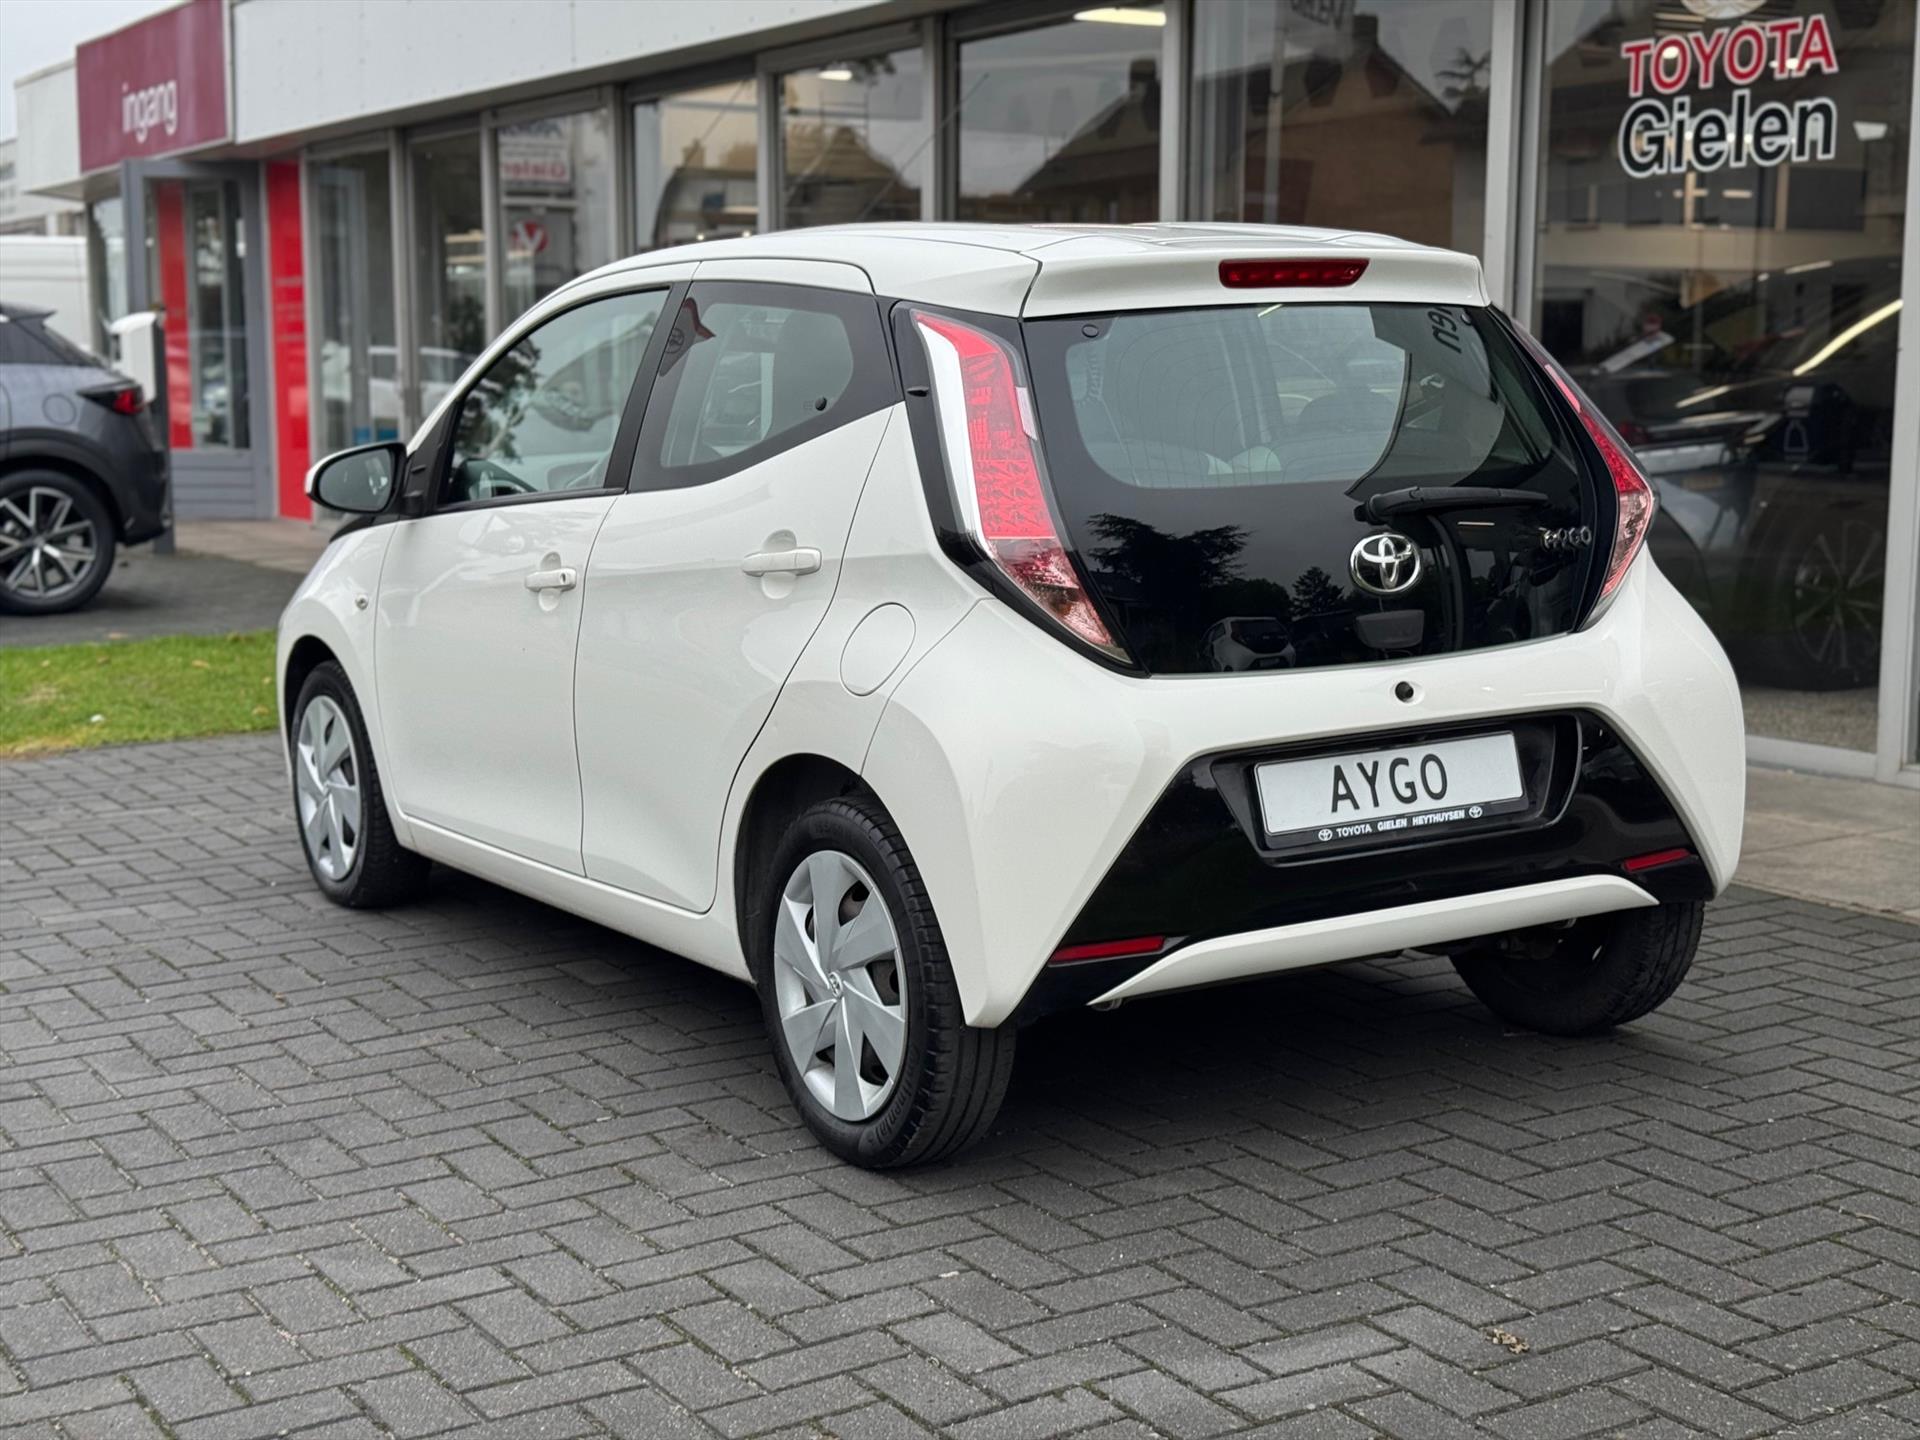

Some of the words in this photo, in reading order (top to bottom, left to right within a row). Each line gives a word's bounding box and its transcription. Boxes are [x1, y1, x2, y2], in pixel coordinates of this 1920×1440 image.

[1621, 14, 1838, 98] TOYOTA
[121, 81, 178, 144] ingang
[1618, 88, 1837, 178] Gielen
[1331, 753, 1448, 813] AYGO
[1336, 825, 1372, 838] TOYOTA
[1377, 818, 1407, 832] GIELEN
[1412, 809, 1465, 827] HEYTHUYSEN
